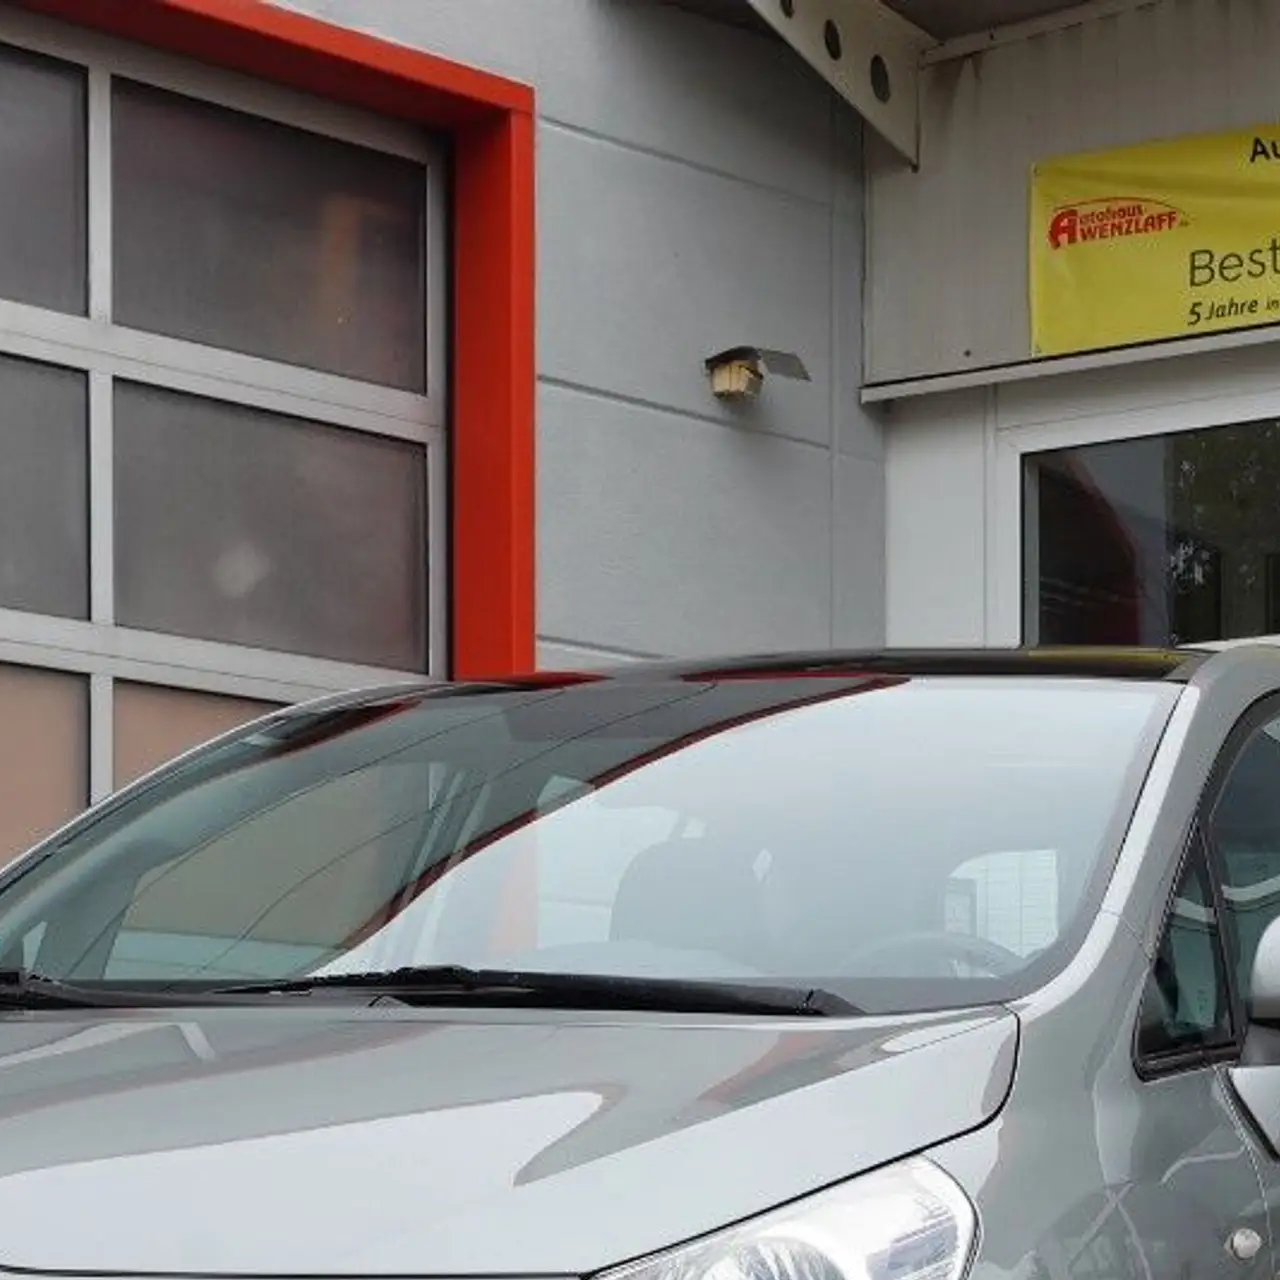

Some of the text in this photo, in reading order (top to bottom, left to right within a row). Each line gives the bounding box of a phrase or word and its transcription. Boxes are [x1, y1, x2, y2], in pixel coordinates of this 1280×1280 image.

[1080, 211, 1178, 241] WENZLAFF
[1187, 301, 1203, 327] 5
[1204, 298, 1259, 321] Jahre
[1266, 294, 1280, 311] in
